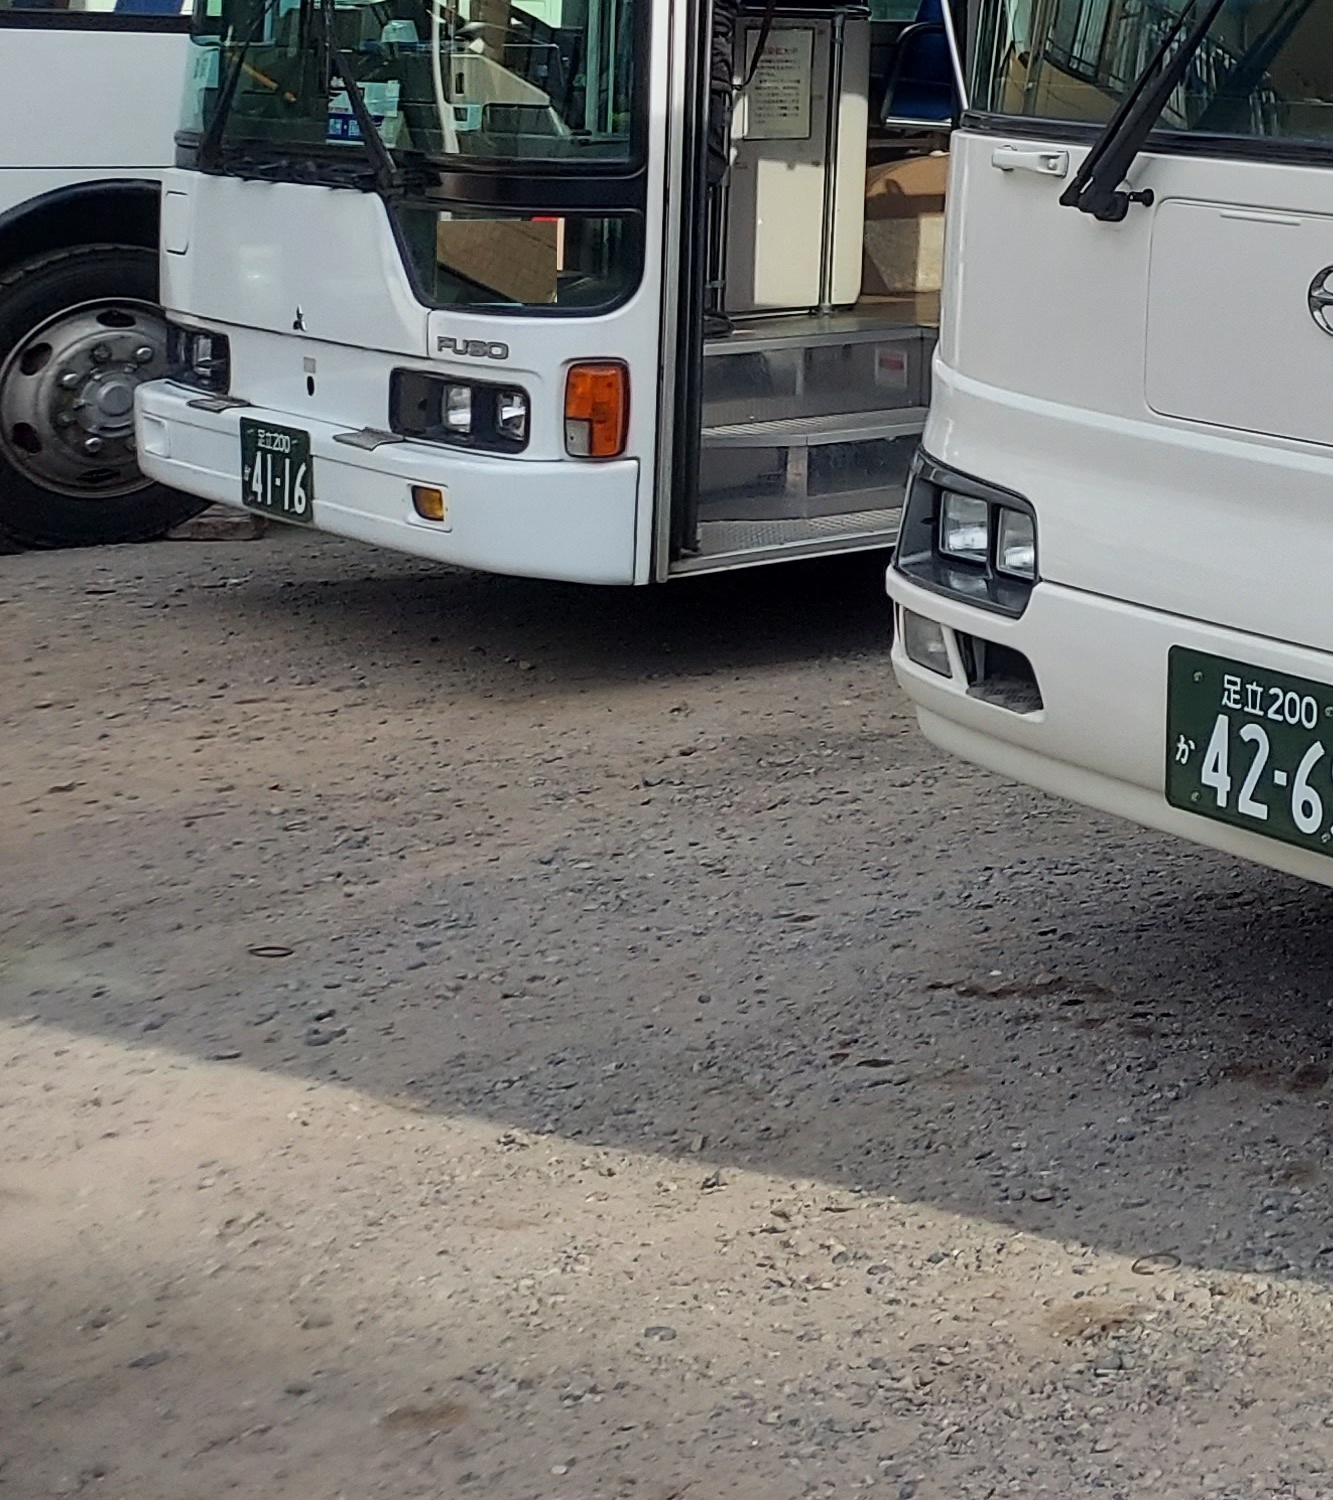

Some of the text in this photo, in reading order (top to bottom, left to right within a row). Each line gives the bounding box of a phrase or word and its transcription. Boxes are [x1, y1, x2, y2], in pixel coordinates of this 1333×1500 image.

[437, 336, 508, 360] FUSO
[252, 451, 307, 514] 41-16
[1221, 673, 1318, 730] 足立200
[1175, 734, 1195, 765] か
